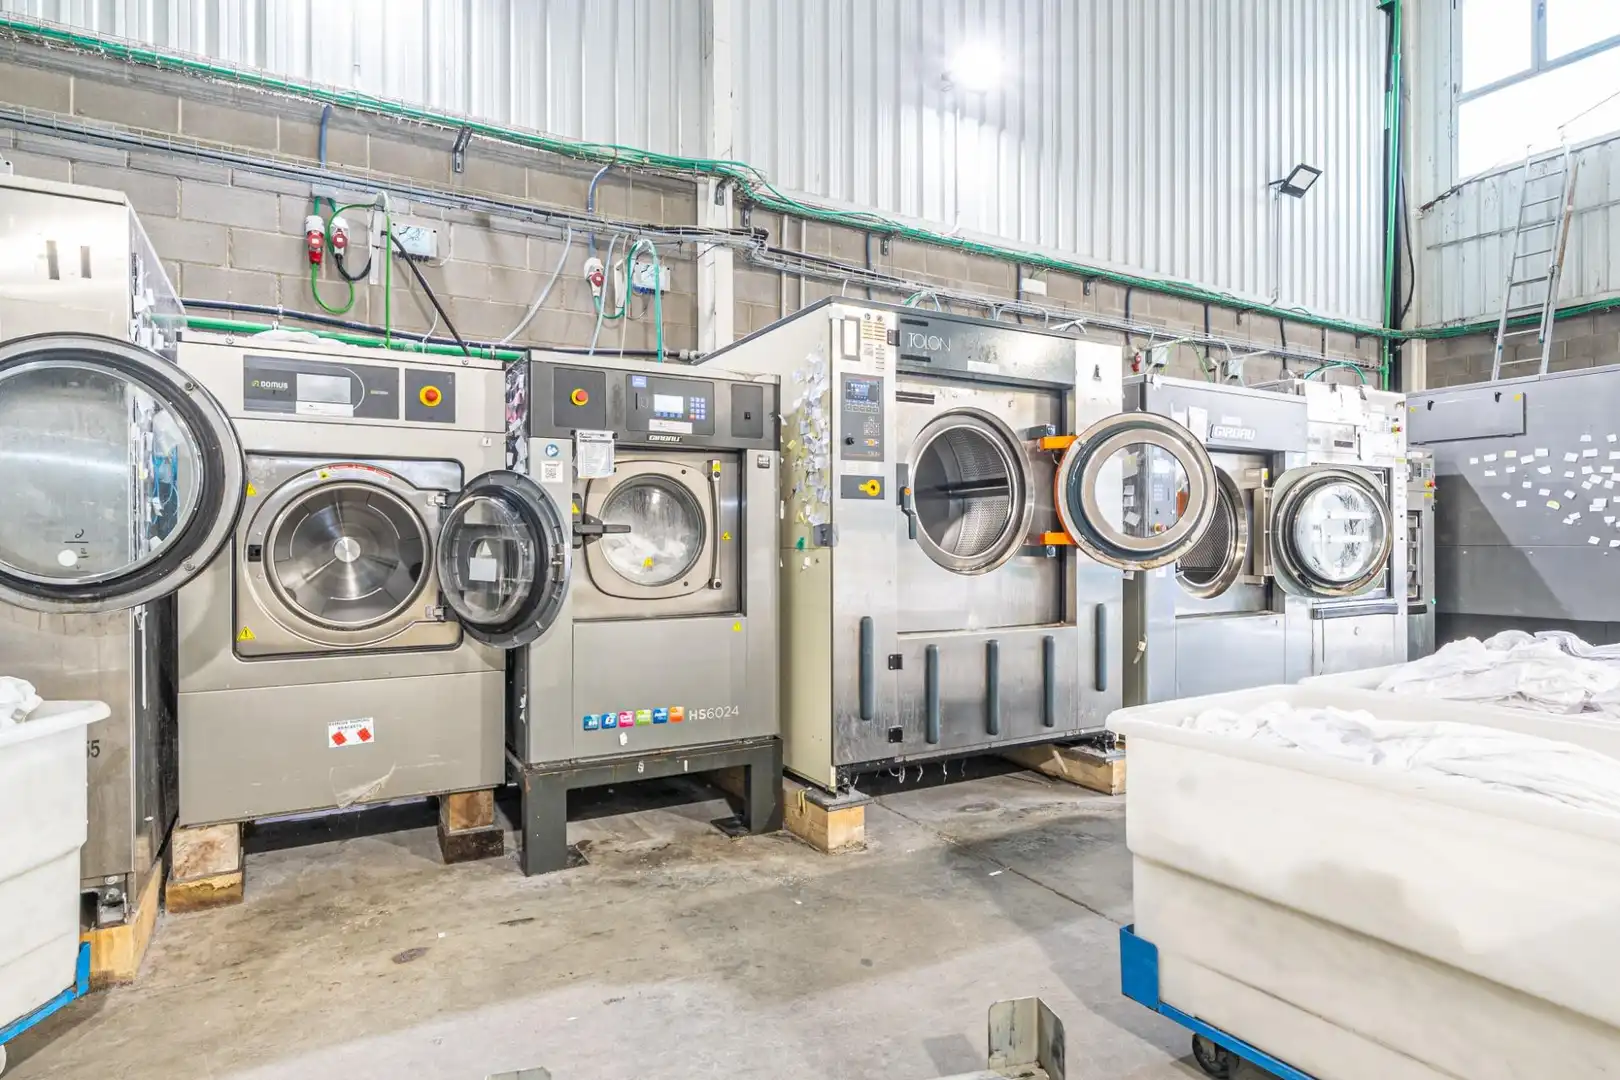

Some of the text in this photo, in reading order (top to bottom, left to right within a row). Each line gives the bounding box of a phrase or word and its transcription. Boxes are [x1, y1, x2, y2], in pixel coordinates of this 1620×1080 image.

[908, 332, 951, 352] TOLON
[260, 380, 289, 389] DOMUS
[688, 705, 740, 721] HS6024
